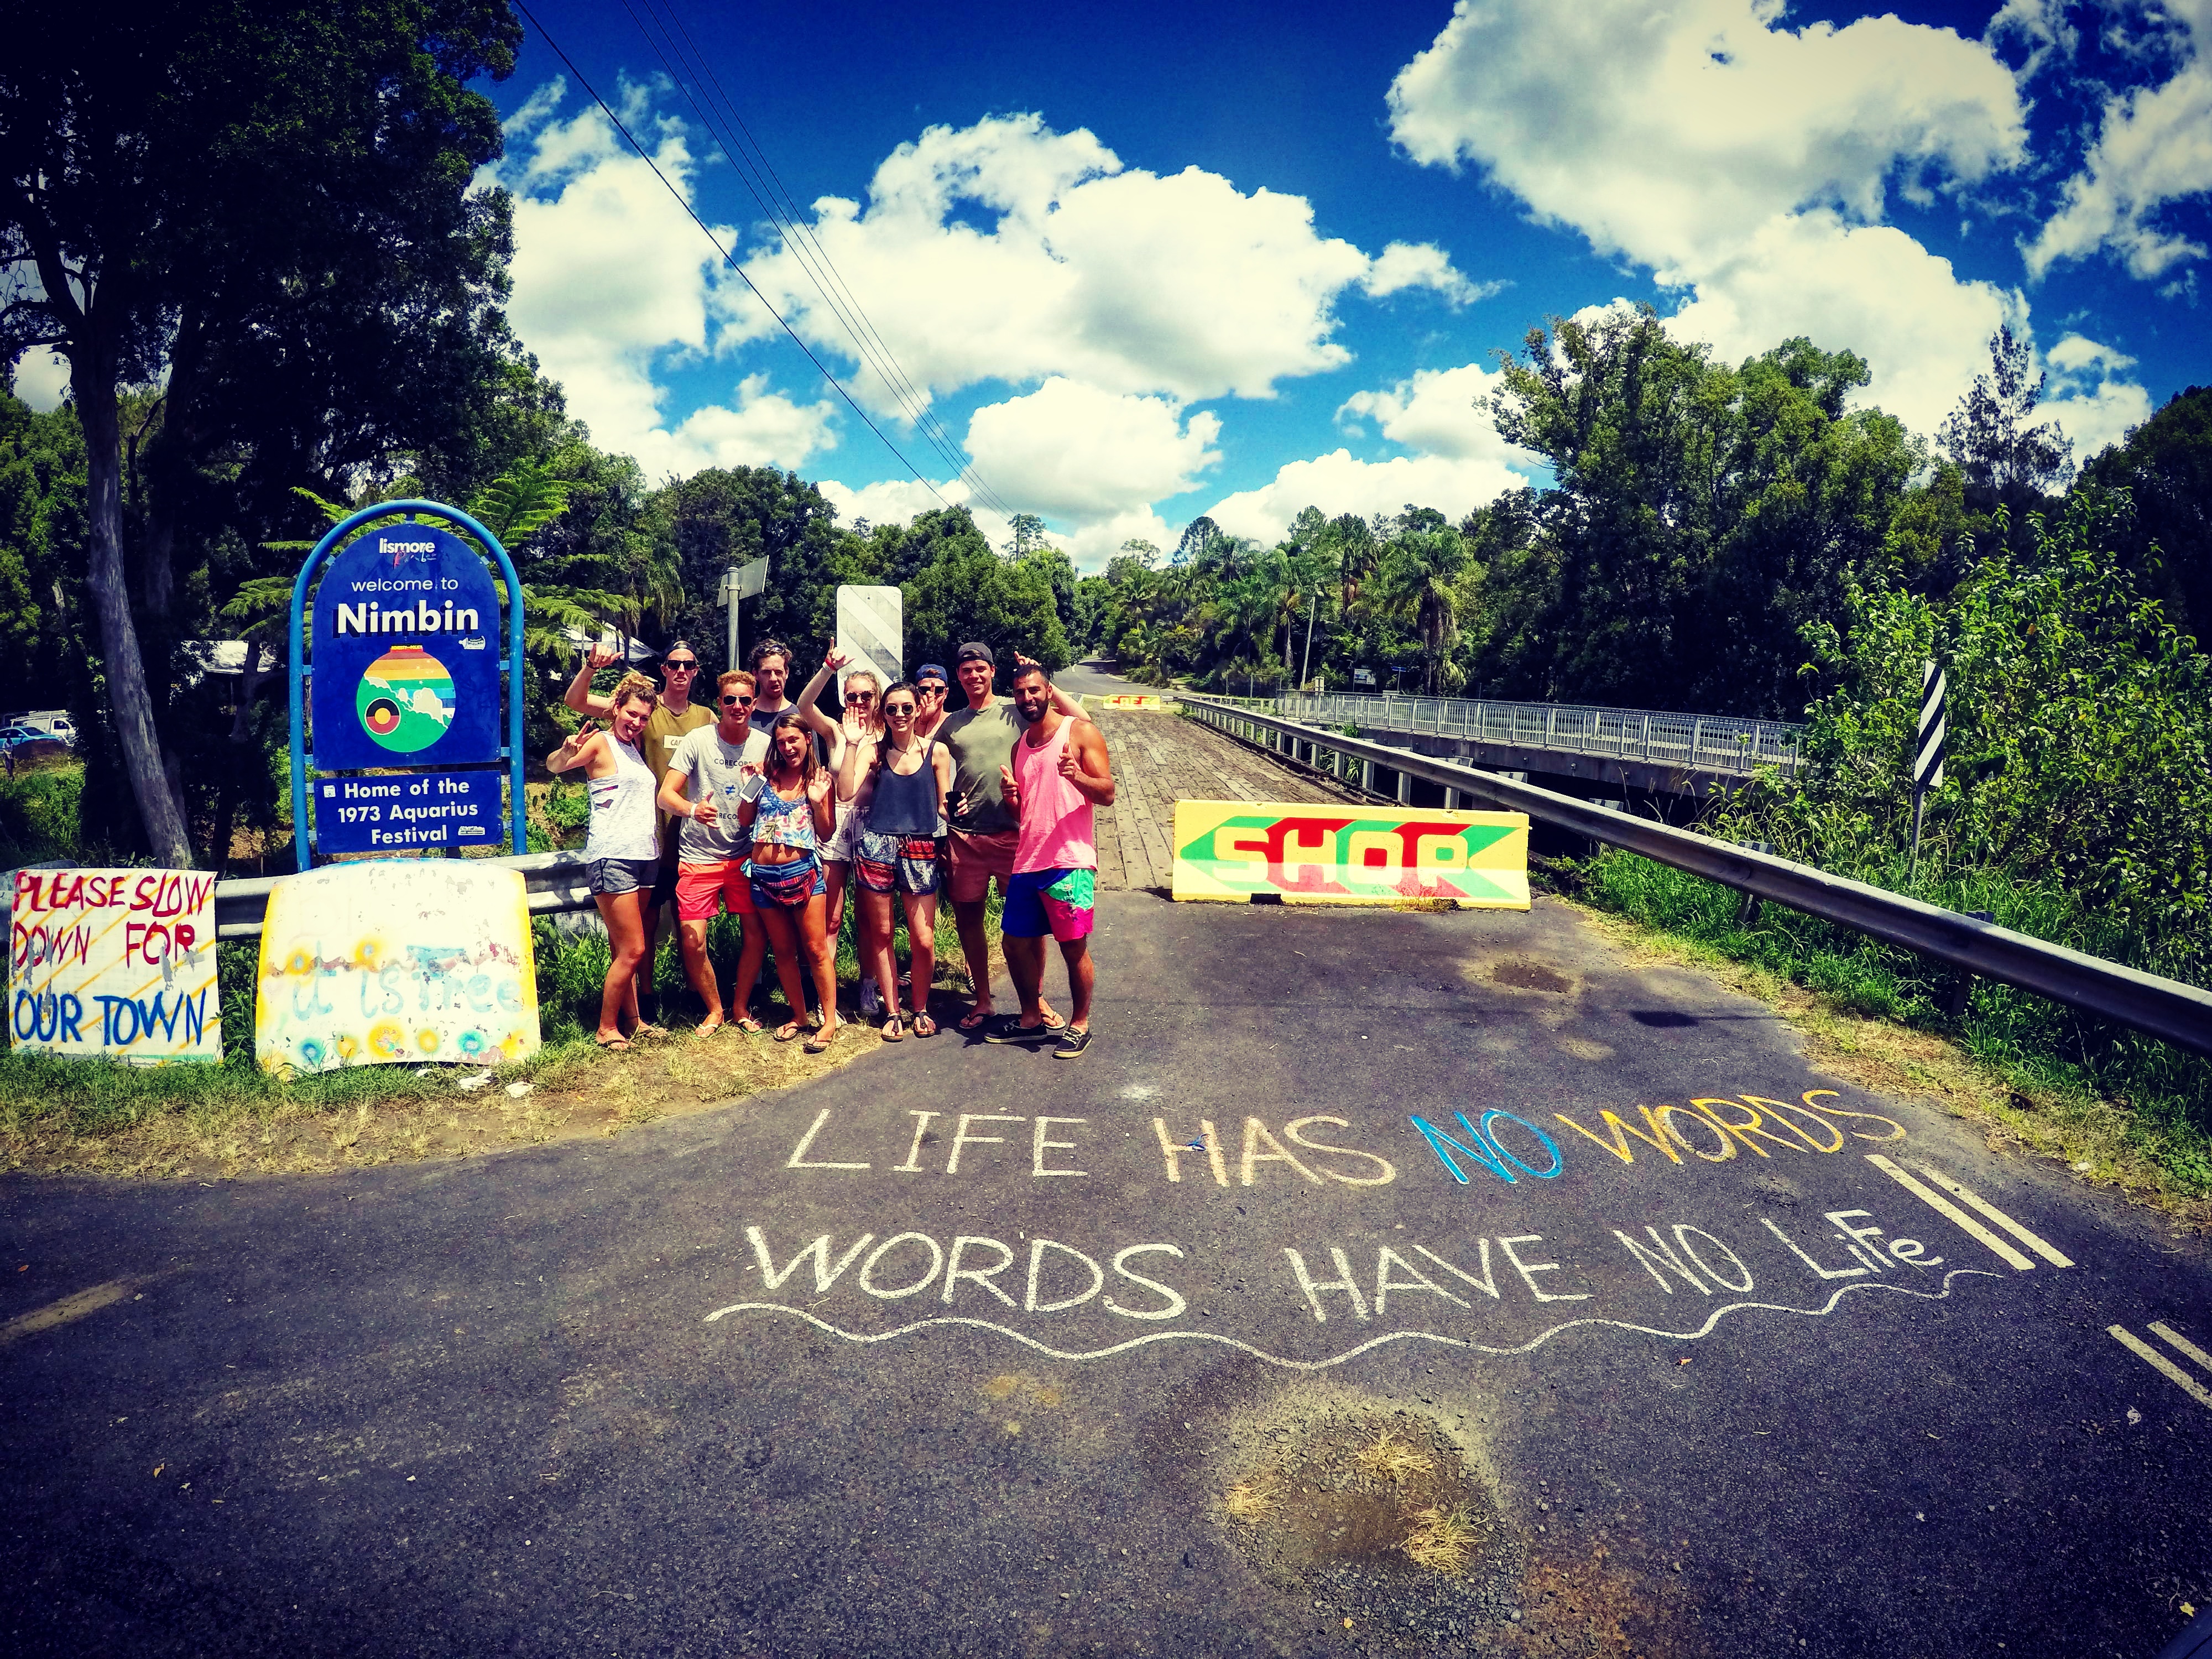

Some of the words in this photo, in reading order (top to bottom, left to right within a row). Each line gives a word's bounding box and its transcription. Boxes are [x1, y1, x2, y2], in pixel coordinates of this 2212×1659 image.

[379, 538, 435, 554] lismore
[351, 578, 433, 592] welcome
[441, 577, 458, 590] to
[338, 599, 478, 634] Nimbin
[345, 783, 401, 799] Home
[409, 778, 429, 795] of
[437, 778, 469, 794] the
[337, 806, 381, 823] 1973
[389, 801, 478, 823] Aquarius
[371, 825, 447, 844] Festival
[1213, 826, 1469, 888] SHOP
[12, 869, 126, 912] PLEASE
[129, 870, 212, 917] SLOW
[13, 921, 91, 968] DOWN
[126, 921, 196, 968] FOR
[14, 988, 84, 1043] OUR
[93, 987, 207, 1045] TOWN
[786, 1108, 1088, 1178] LIFE
[1152, 1114, 1397, 1187] HAS
[1410, 1108, 1563, 1185] NO
[1554, 1089, 1906, 1166] WORDS
[745, 1225, 1188, 1321] WORDS
[1283, 1234, 1595, 1323] HAVE
[1612, 1224, 1755, 1296] NO
